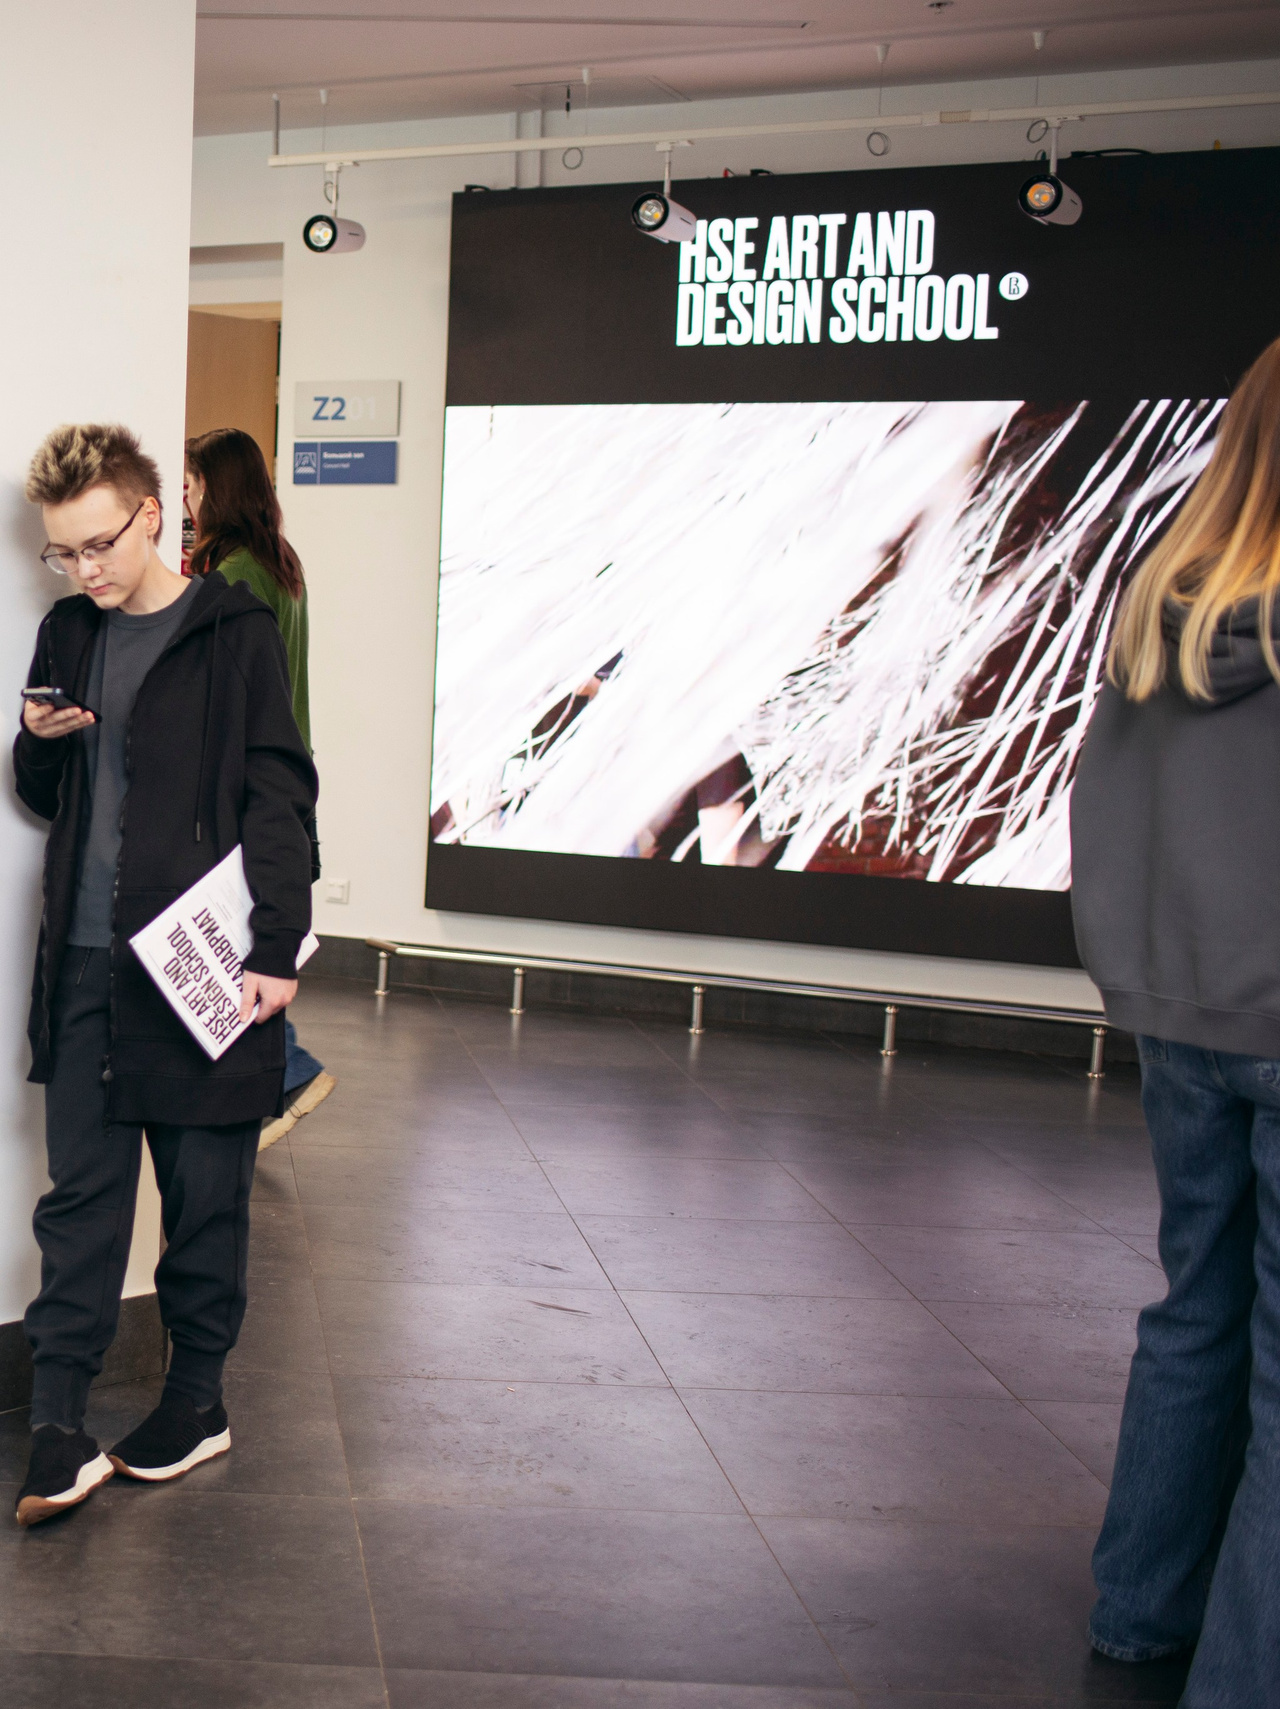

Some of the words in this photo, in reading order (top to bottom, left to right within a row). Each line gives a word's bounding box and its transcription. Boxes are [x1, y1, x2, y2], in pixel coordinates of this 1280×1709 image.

[678, 217, 759, 283] HSE
[762, 213, 847, 280] ART
[846, 209, 935, 277] AND
[675, 278, 823, 346] DESIGN
[828, 273, 999, 344] SCHOOL
[163, 956, 192, 991] AND
[167, 921, 210, 983] SCHOOL
[191, 907, 243, 992] АЛАВРИАТ
[181, 986, 211, 1017] ART
[200, 975, 241, 1030] DESIGN
[202, 1010, 232, 1045] HSE
